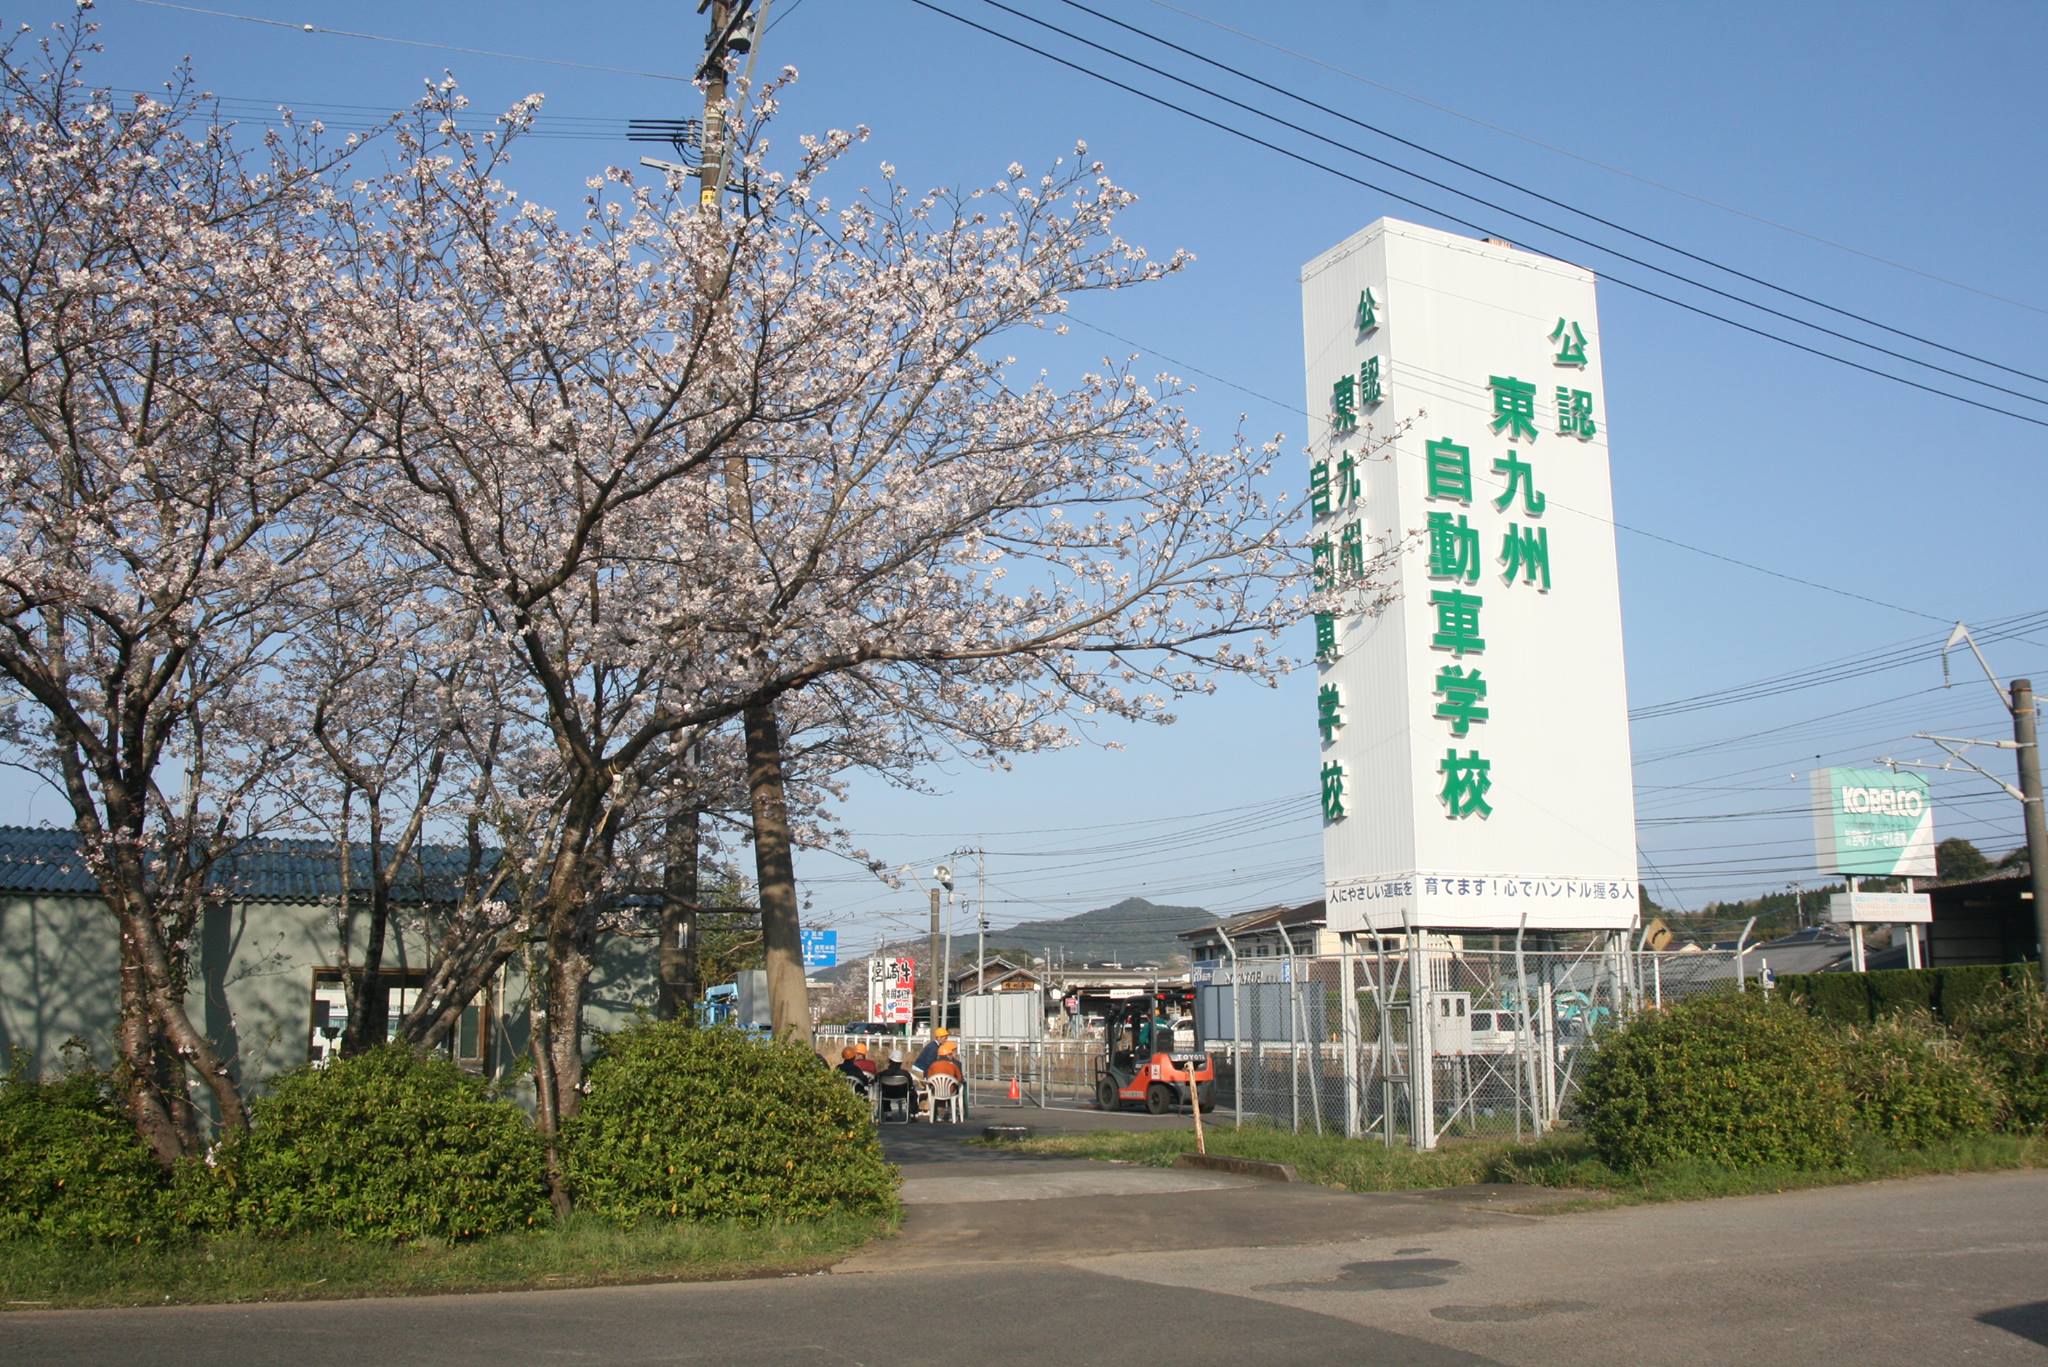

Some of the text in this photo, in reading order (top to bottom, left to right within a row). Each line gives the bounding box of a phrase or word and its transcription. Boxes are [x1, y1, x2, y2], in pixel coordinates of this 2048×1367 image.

[1358, 286, 1381, 403] 公認
[1552, 317, 1597, 438] 公認
[1490, 376, 1552, 591] 東九州
[1426, 437, 1492, 816] 自動車学校
[1842, 786, 1924, 817] KOBELCO
[1329, 881, 1413, 904] 人にやさしい運転を
[871, 960, 911, 983] 宮崎牛
[1177, 1053, 1205, 1061] TOYOTA
